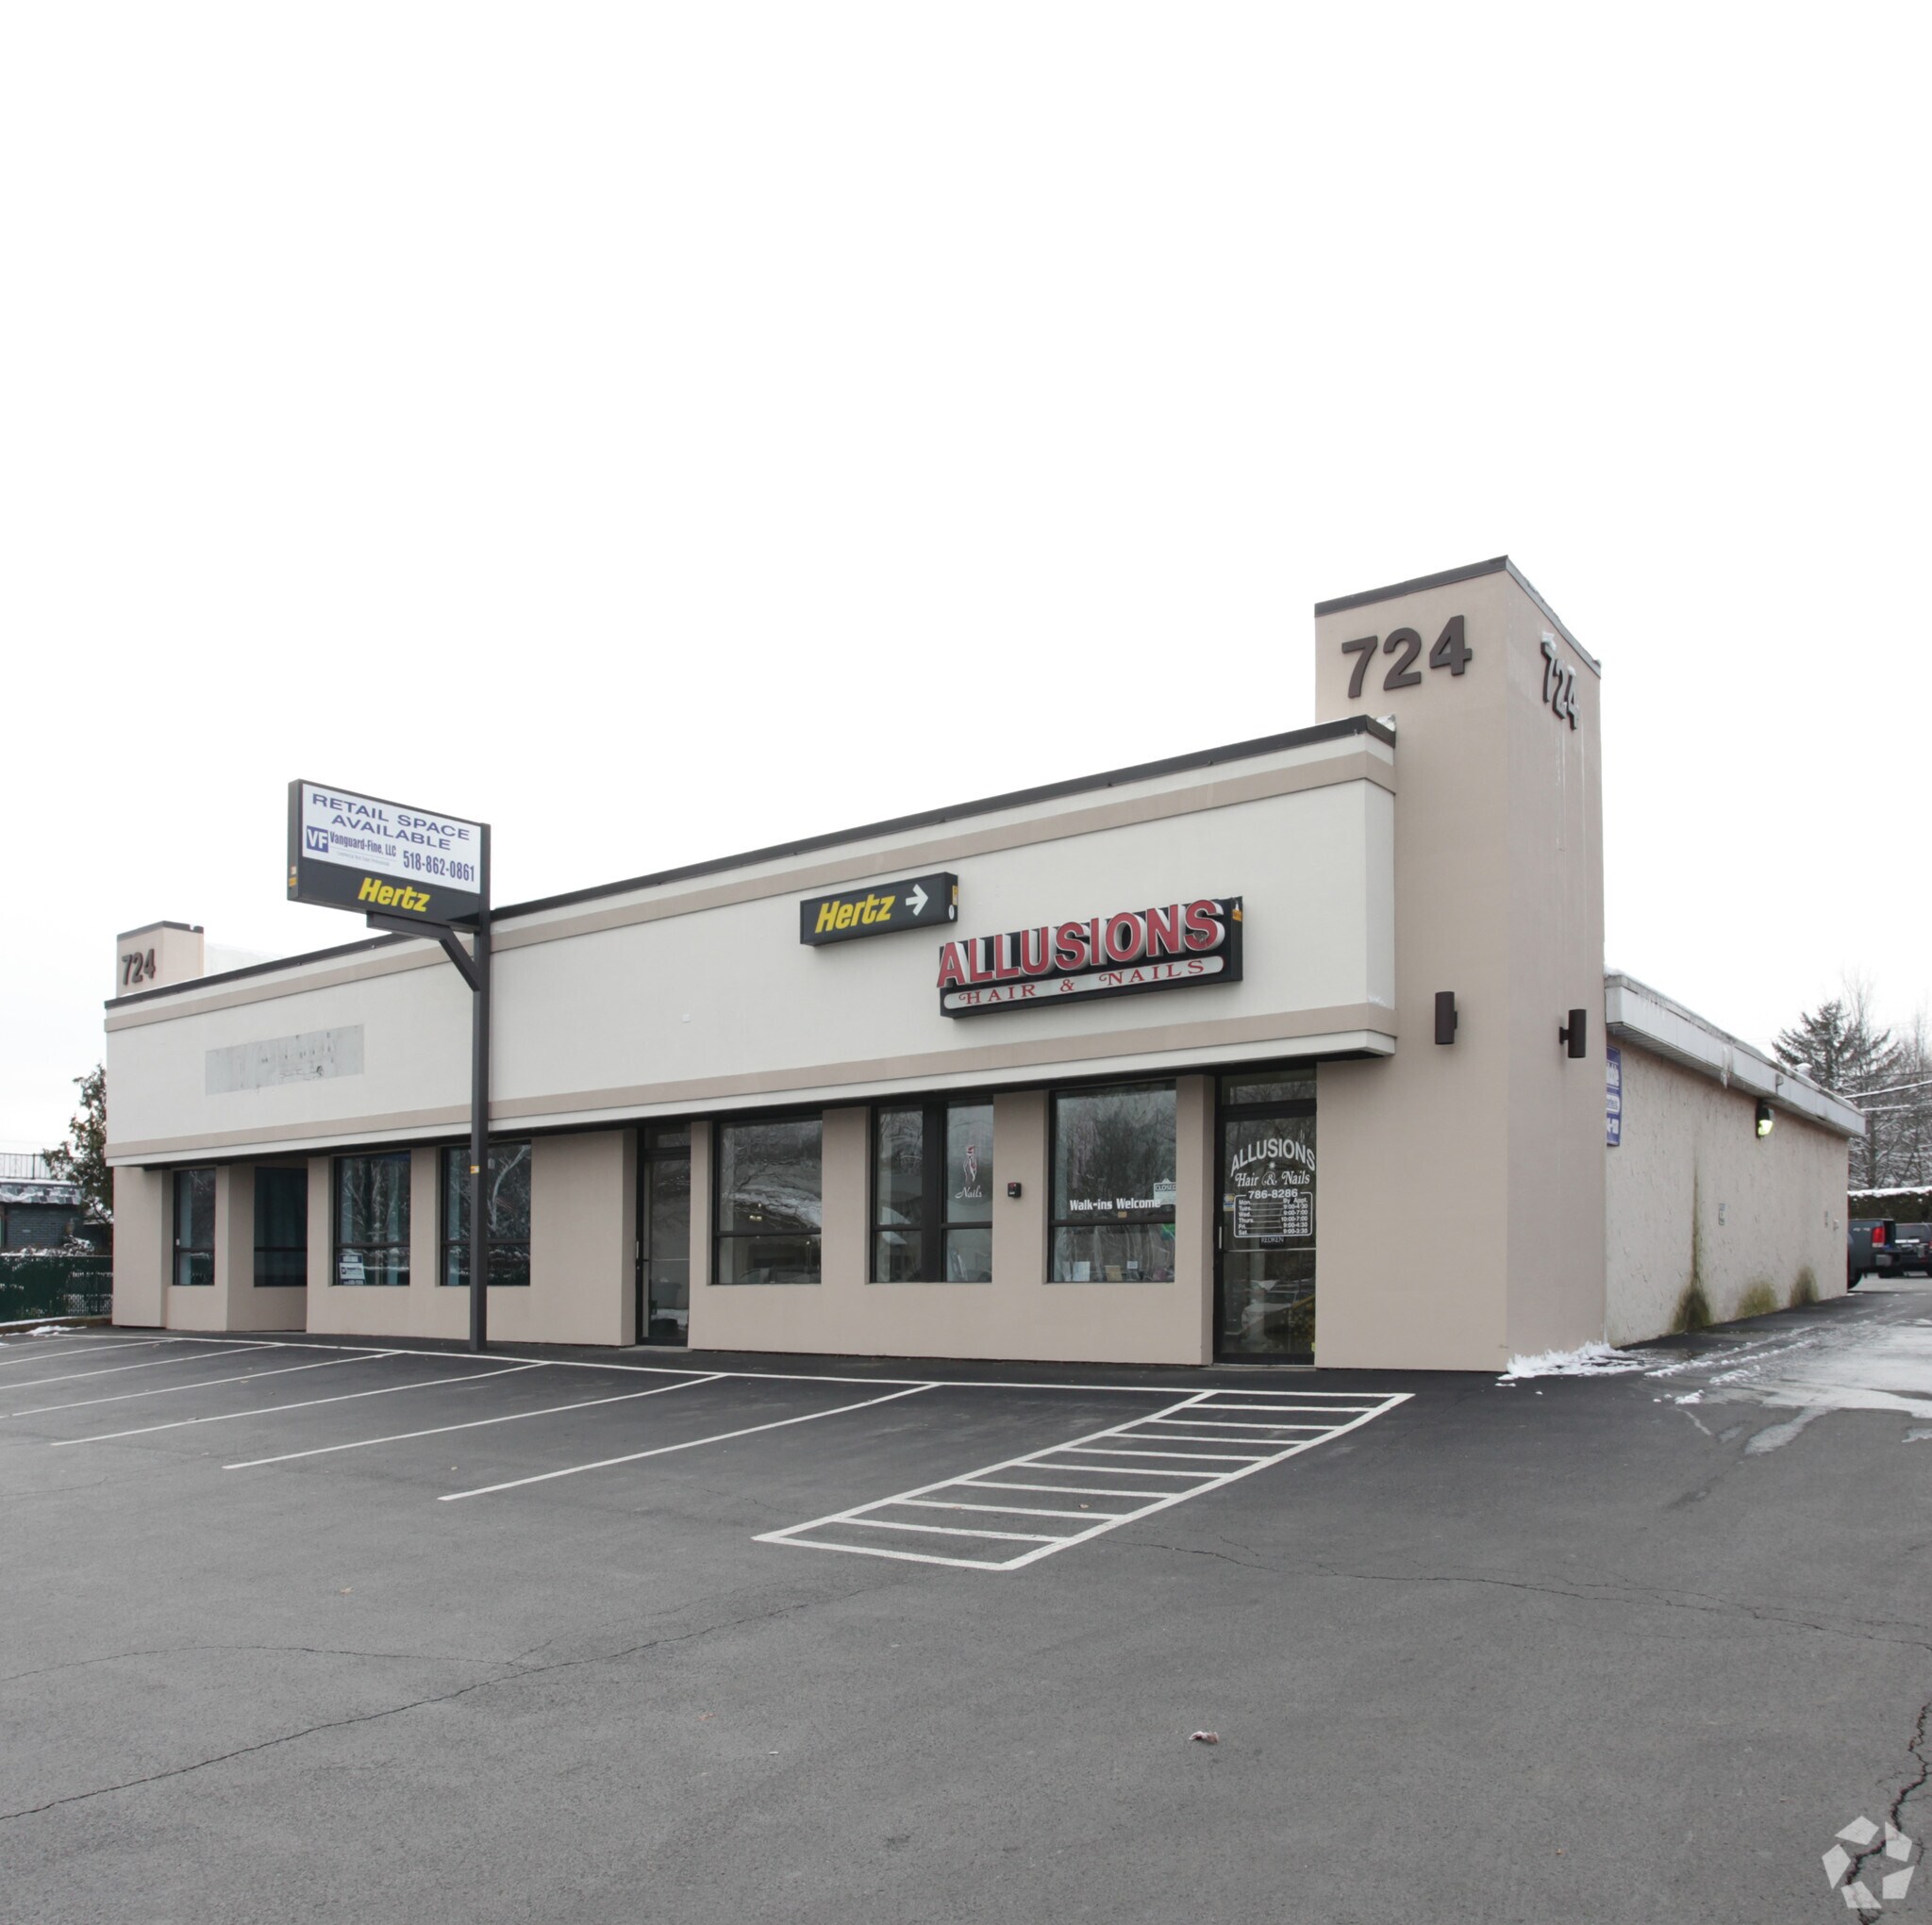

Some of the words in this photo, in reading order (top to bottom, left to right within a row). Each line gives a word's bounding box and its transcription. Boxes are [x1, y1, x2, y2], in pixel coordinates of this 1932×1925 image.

[1341, 614, 1473, 698] 724
[1540, 639, 1579, 730] 724
[312, 793, 390, 821] RETAIL
[397, 814, 470, 840] SPACE
[331, 815, 451, 851] AVAILABLE
[307, 827, 329, 852] VF
[330, 831, 384, 855] Vanguard-Fine,
[385, 845, 397, 857] LLC
[403, 850, 475, 882] 518-862-0861
[358, 877, 431, 912] Hertz
[814, 893, 896, 934] Hertz
[937, 899, 1225, 988] ALLUSIONS
[121, 948, 157, 986] 724
[958, 983, 1036, 1005] HAIR
[1059, 978, 1075, 993] &
[1098, 959, 1205, 987] NAILS
[1230, 1137, 1316, 1178] ALLUSIONS
[955, 1186, 982, 1200] Nails
[1234, 1172, 1259, 1187] Hair
[1261, 1170, 1277, 1187] &
[1281, 1170, 1310, 1186] Nails
[1247, 1188, 1299, 1199] 786-8286
[1069, 1199, 1113, 1211] Walk-ins
[1115, 1197, 1162, 1211] Welcome
